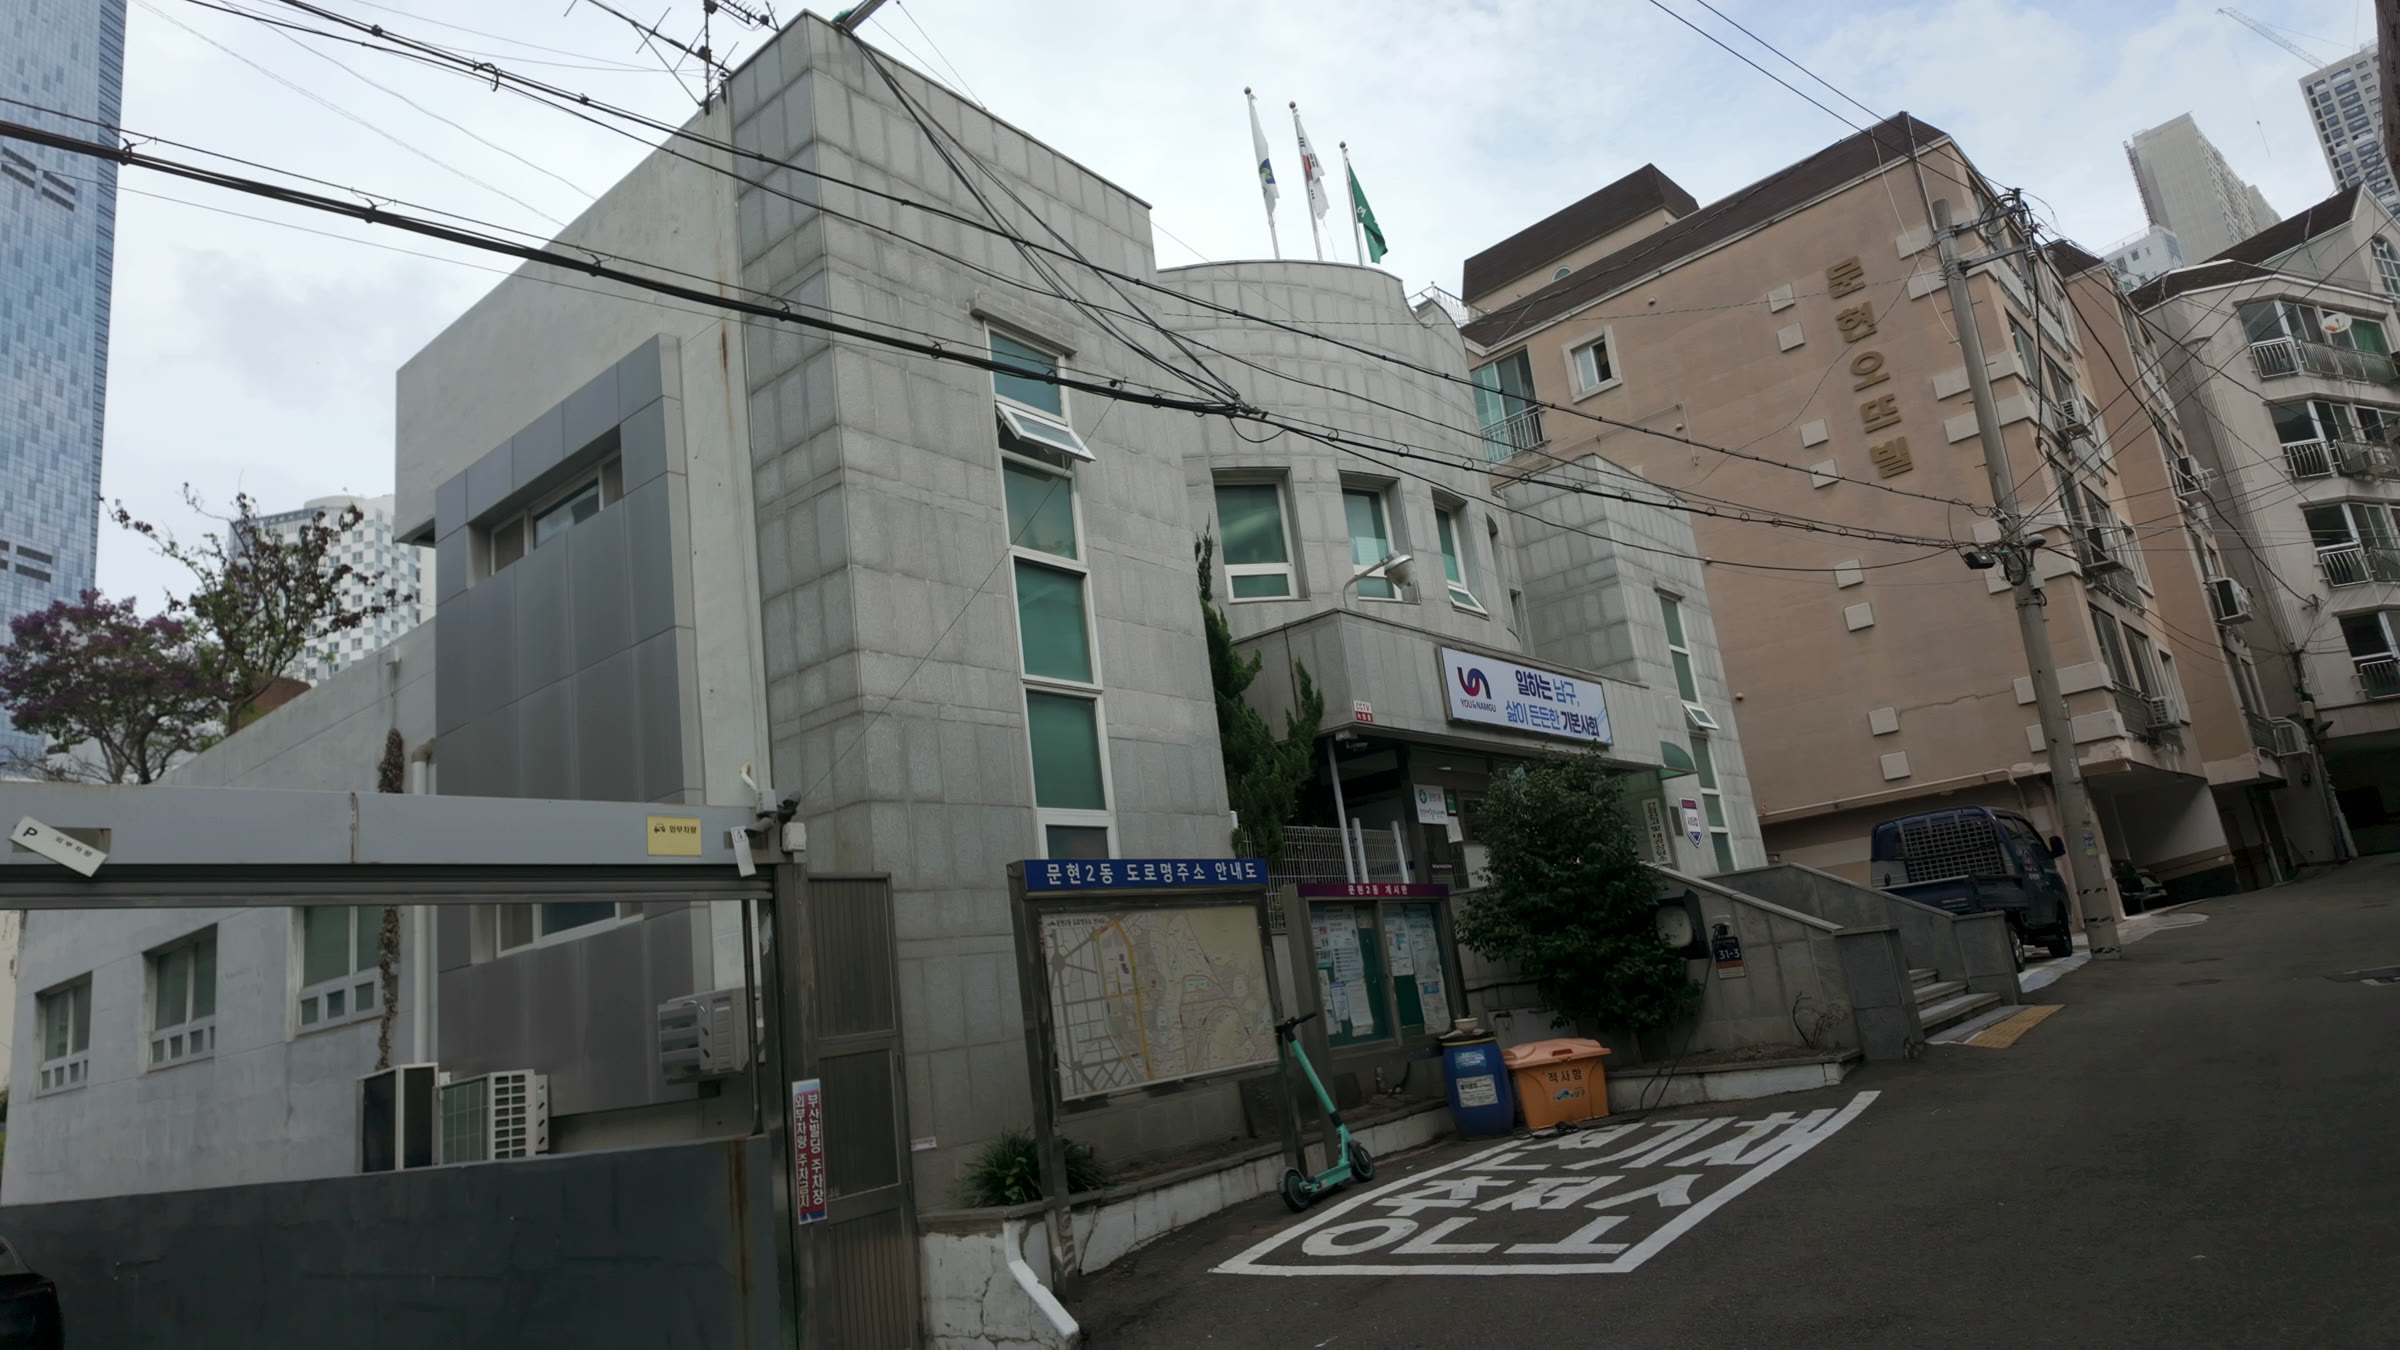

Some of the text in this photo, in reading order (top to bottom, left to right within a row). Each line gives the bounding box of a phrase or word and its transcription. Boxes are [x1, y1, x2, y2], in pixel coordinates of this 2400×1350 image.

[1826, 255, 1913, 478] 문현오뜨빌
[1515, 669, 1580, 707] 일하는 남구,
[1355, 702, 1370, 711] CCTV
[1506, 700, 1600, 737] 삶이 든든한 기본사회
[22, 826, 38, 837] P
[669, 825, 697, 834] 외부차량
[1046, 860, 1258, 885] 문현2동 도로명주소 안내도
[1347, 884, 1408, 896] 문현2동 게시판
[1719, 948, 1740, 959] 31-3
[1548, 1068, 1582, 1083] 적사함
[794, 1094, 810, 1208] 외부차량 주차금지
[811, 1159, 824, 1206] 주차장
[1302, 1173, 1704, 1257] 충전소
